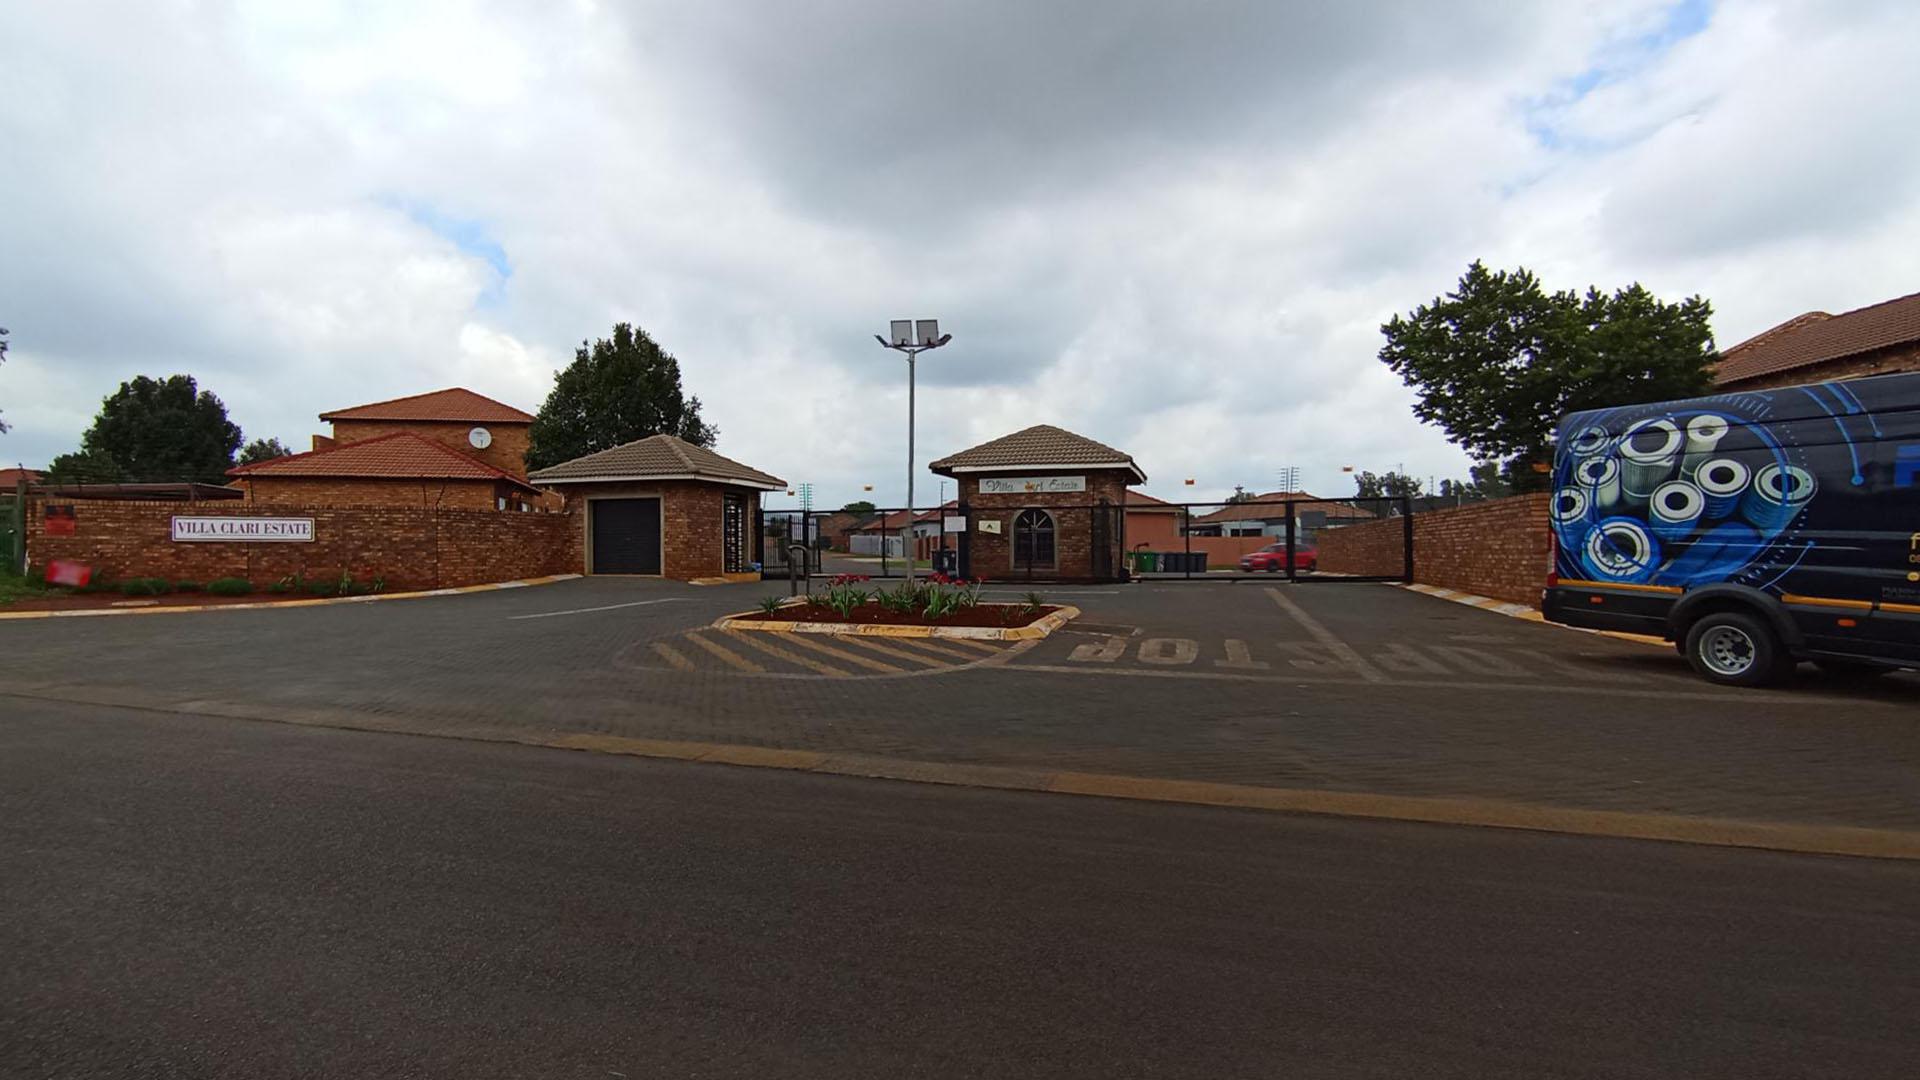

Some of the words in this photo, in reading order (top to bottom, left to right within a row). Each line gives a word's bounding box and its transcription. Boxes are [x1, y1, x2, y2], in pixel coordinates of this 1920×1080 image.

[178, 522, 216, 534] VILLA
[220, 522, 260, 534] CLARI
[264, 523, 310, 535] ESTATE
